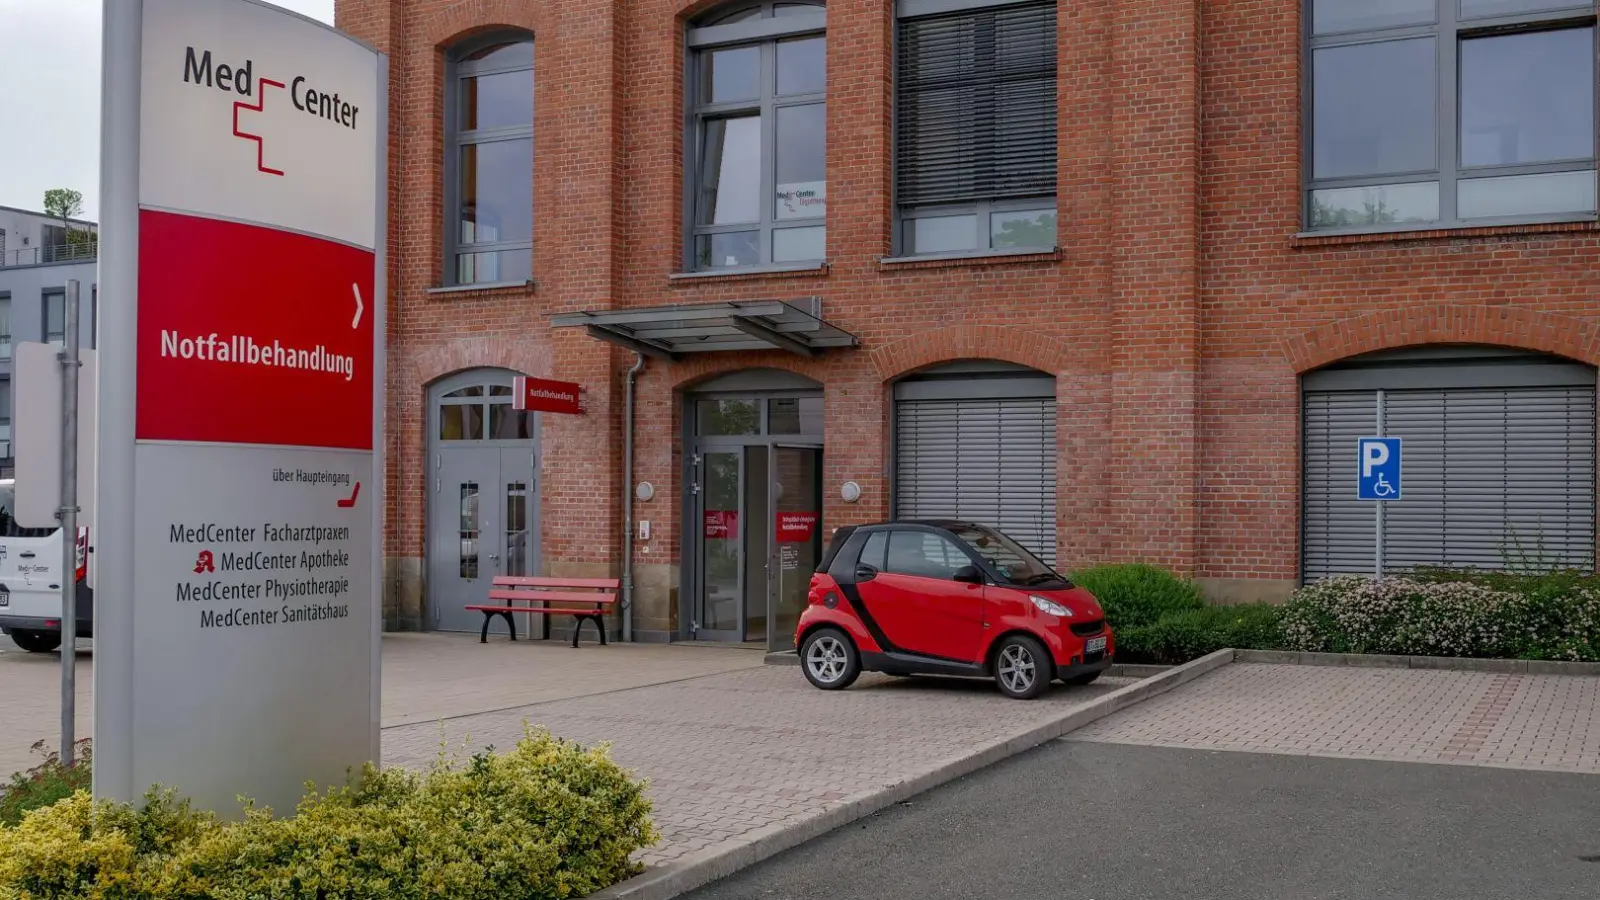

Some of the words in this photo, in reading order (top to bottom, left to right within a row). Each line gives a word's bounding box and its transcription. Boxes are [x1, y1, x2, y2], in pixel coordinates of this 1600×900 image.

[184, 46, 252, 97] Med
[291, 76, 359, 130] Center
[160, 328, 354, 381] Notfallbehandlung
[529, 388, 574, 403] Notfallbehandlung
[1363, 442, 1389, 477] P
[272, 468, 294, 482] über
[296, 470, 350, 486] Haupteingang
[170, 523, 256, 543] MedCenter
[264, 523, 349, 545] Facharztpraxen
[221, 552, 297, 571] MedCenter
[300, 549, 349, 572] Apotheke
[176, 581, 261, 602] MedCenter
[265, 576, 349, 601] Physiotherapie
[200, 608, 278, 628] MedCenter
[281, 602, 349, 625] Sanitätshaus
